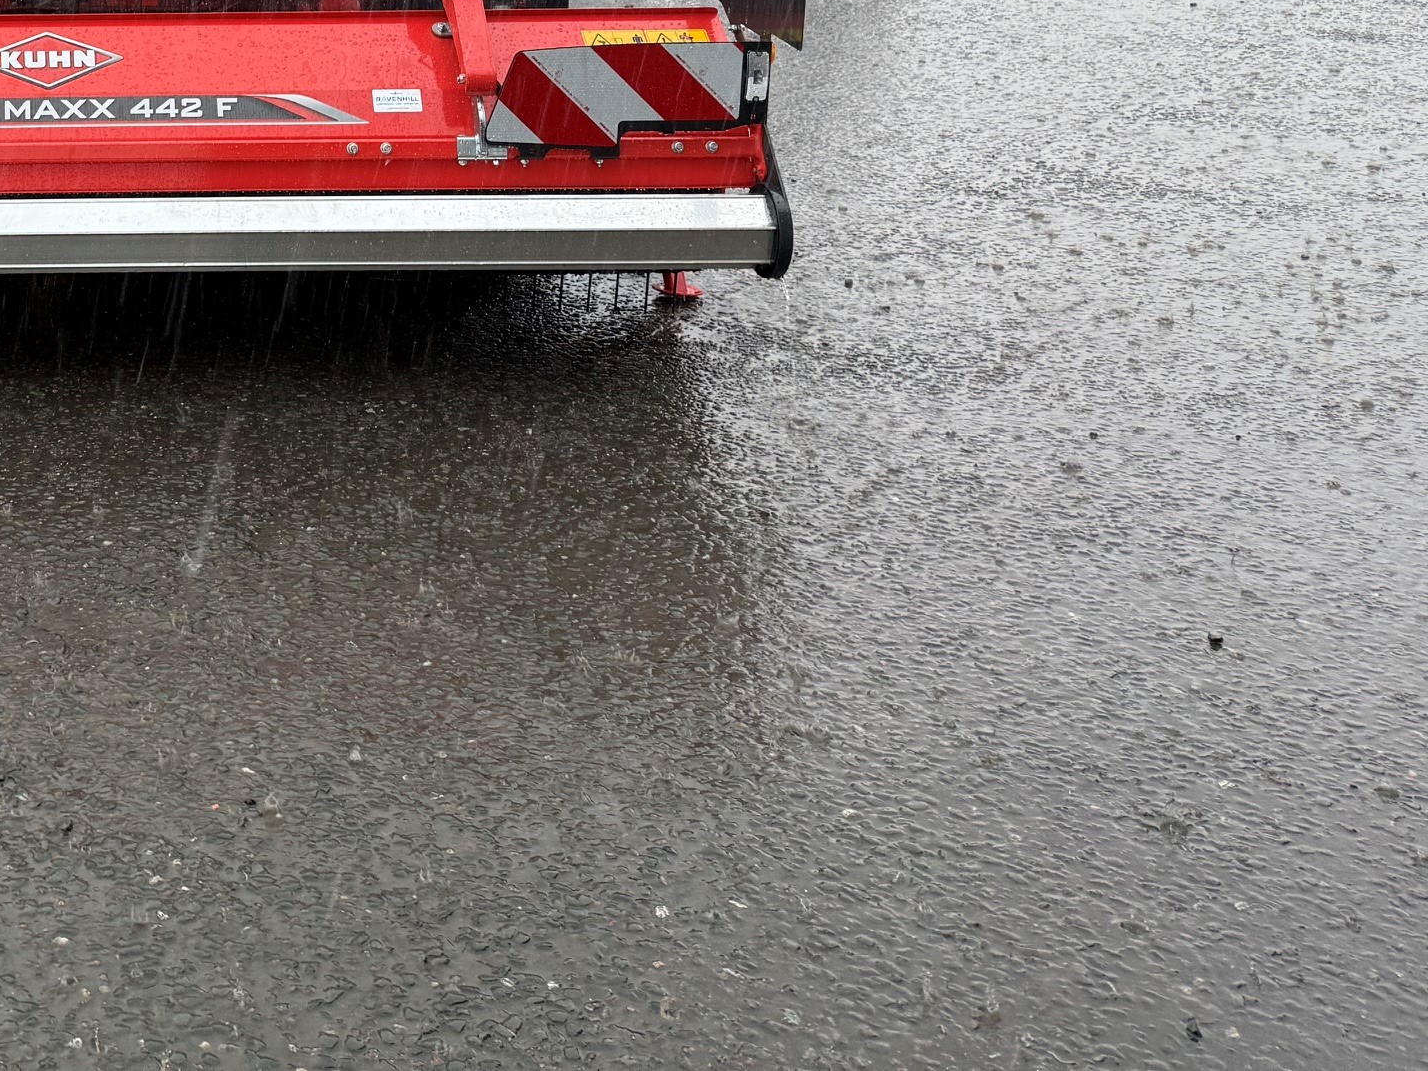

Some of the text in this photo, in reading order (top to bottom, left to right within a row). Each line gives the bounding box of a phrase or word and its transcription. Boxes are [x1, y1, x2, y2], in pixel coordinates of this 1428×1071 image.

[0, 48, 96, 70] KUHN
[4, 98, 116, 121] MAXX
[129, 97, 203, 119] 442
[216, 96, 238, 118] F
